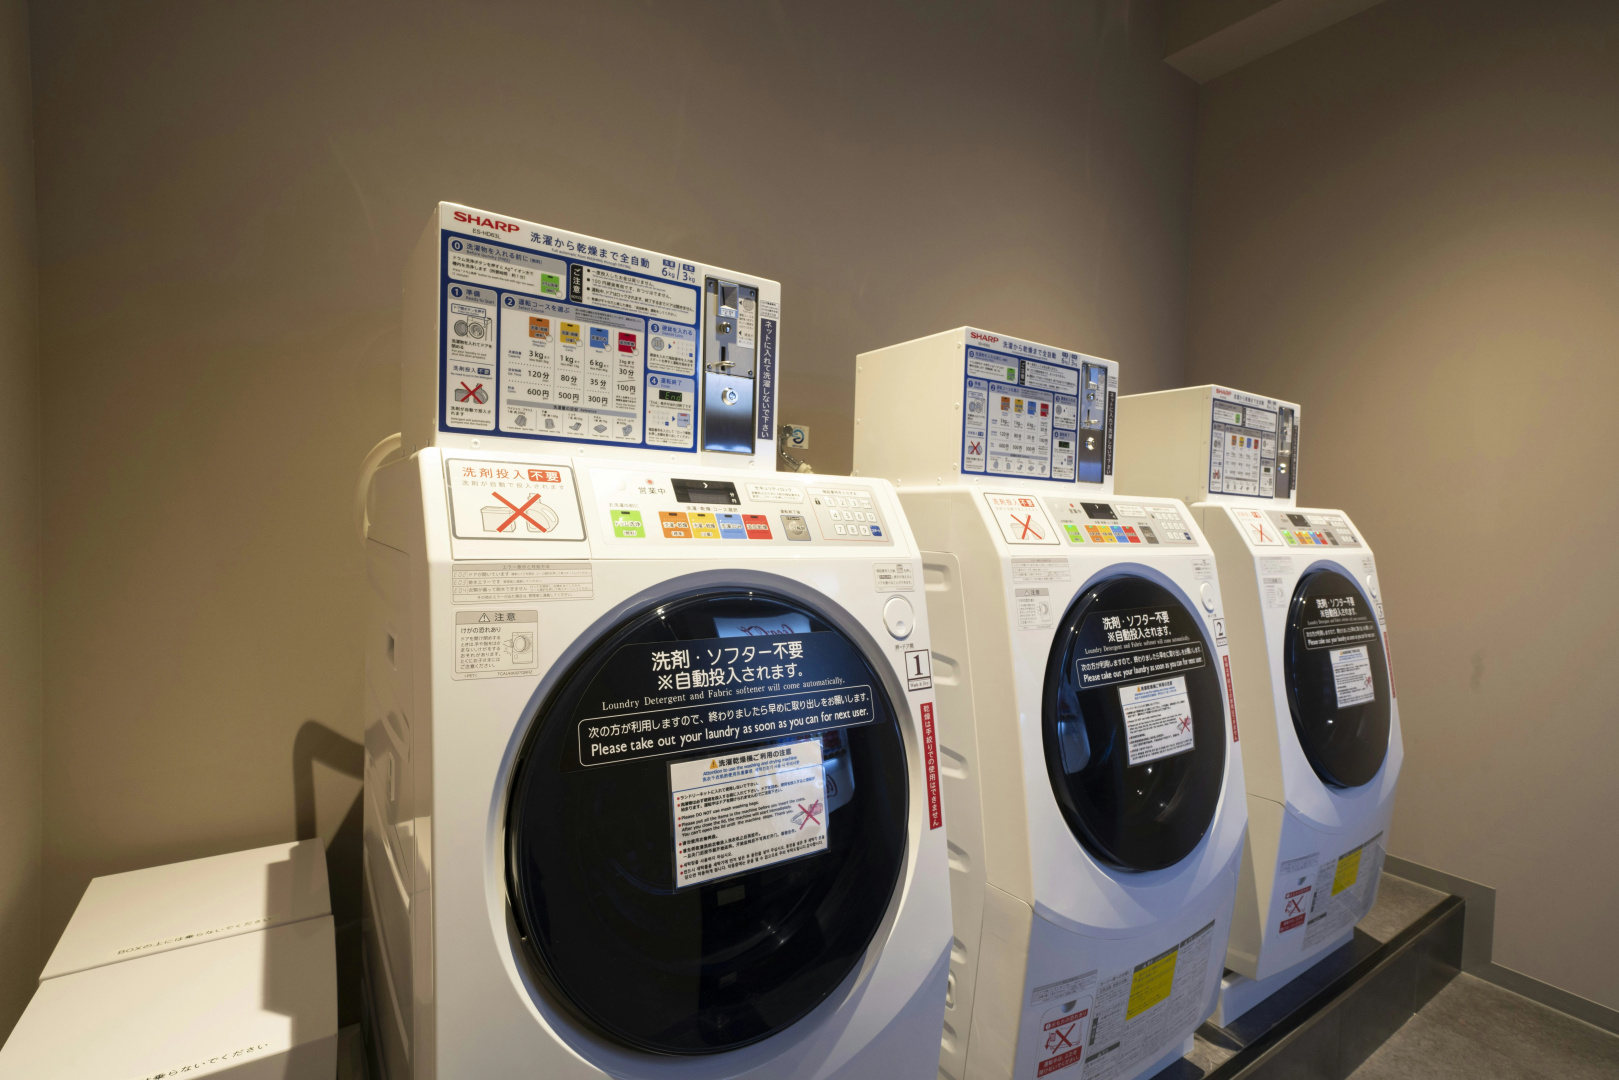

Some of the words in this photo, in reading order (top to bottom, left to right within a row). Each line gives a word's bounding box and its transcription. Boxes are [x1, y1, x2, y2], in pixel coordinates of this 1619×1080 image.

[453, 211, 520, 233] SHARP
[466, 242, 529, 262] 洗濯物を入れる前に
[530, 231, 650, 269] 洗濯から乾燥まで全自動
[518, 299, 570, 314] 運転コースを選ぶ
[661, 324, 693, 336] 硬貨を入れる
[970, 331, 999, 344] SHARP
[761, 320, 773, 438] ネットに入れて洗濯しないで下さい
[527, 388, 550, 398] 600円
[558, 391, 580, 401] 500円
[588, 395, 608, 405] 300円
[462, 466, 526, 480] 洗剤投入
[530, 470, 560, 482] 不要
[494, 612, 517, 622] 注意
[1102, 610, 1170, 630] 洗剤・ソフター不要
[460, 626, 502, 634] けがの恐れあり
[1216, 621, 1223, 636] 2
[651, 640, 804, 672] 洗剤・ソフター不要
[913, 654, 924, 676] 1
[657, 662, 803, 691] ※自動投入されます。
[1083, 673, 1101, 683] Please
[602, 699, 640, 711] Loundry
[644, 693, 686, 706] Detergent
[689, 691, 705, 701] and
[708, 687, 733, 698] Fabric
[735, 684, 765, 695] softener
[767, 683, 781, 691] will
[783, 682, 800, 690] come
[591, 741, 627, 757] Please
[630, 737, 654, 751] take
[657, 735, 677, 747] out
[680, 731, 703, 747] your
[705, 725, 740, 739] laundry
[742, 725, 753, 735] as
[754, 720, 776, 733] soon
[778, 720, 788, 729] as
[789, 718, 804, 730] you
[805, 716, 819, 725] can
[820, 711, 833, 723] for
[834, 709, 851, 721] next
[852, 708, 869, 718] user.
[718, 748, 792, 767] 洗濯乾燥機ご利用の注意
[923, 705, 940, 827] 乾燥は手絞りでの使用はできません
